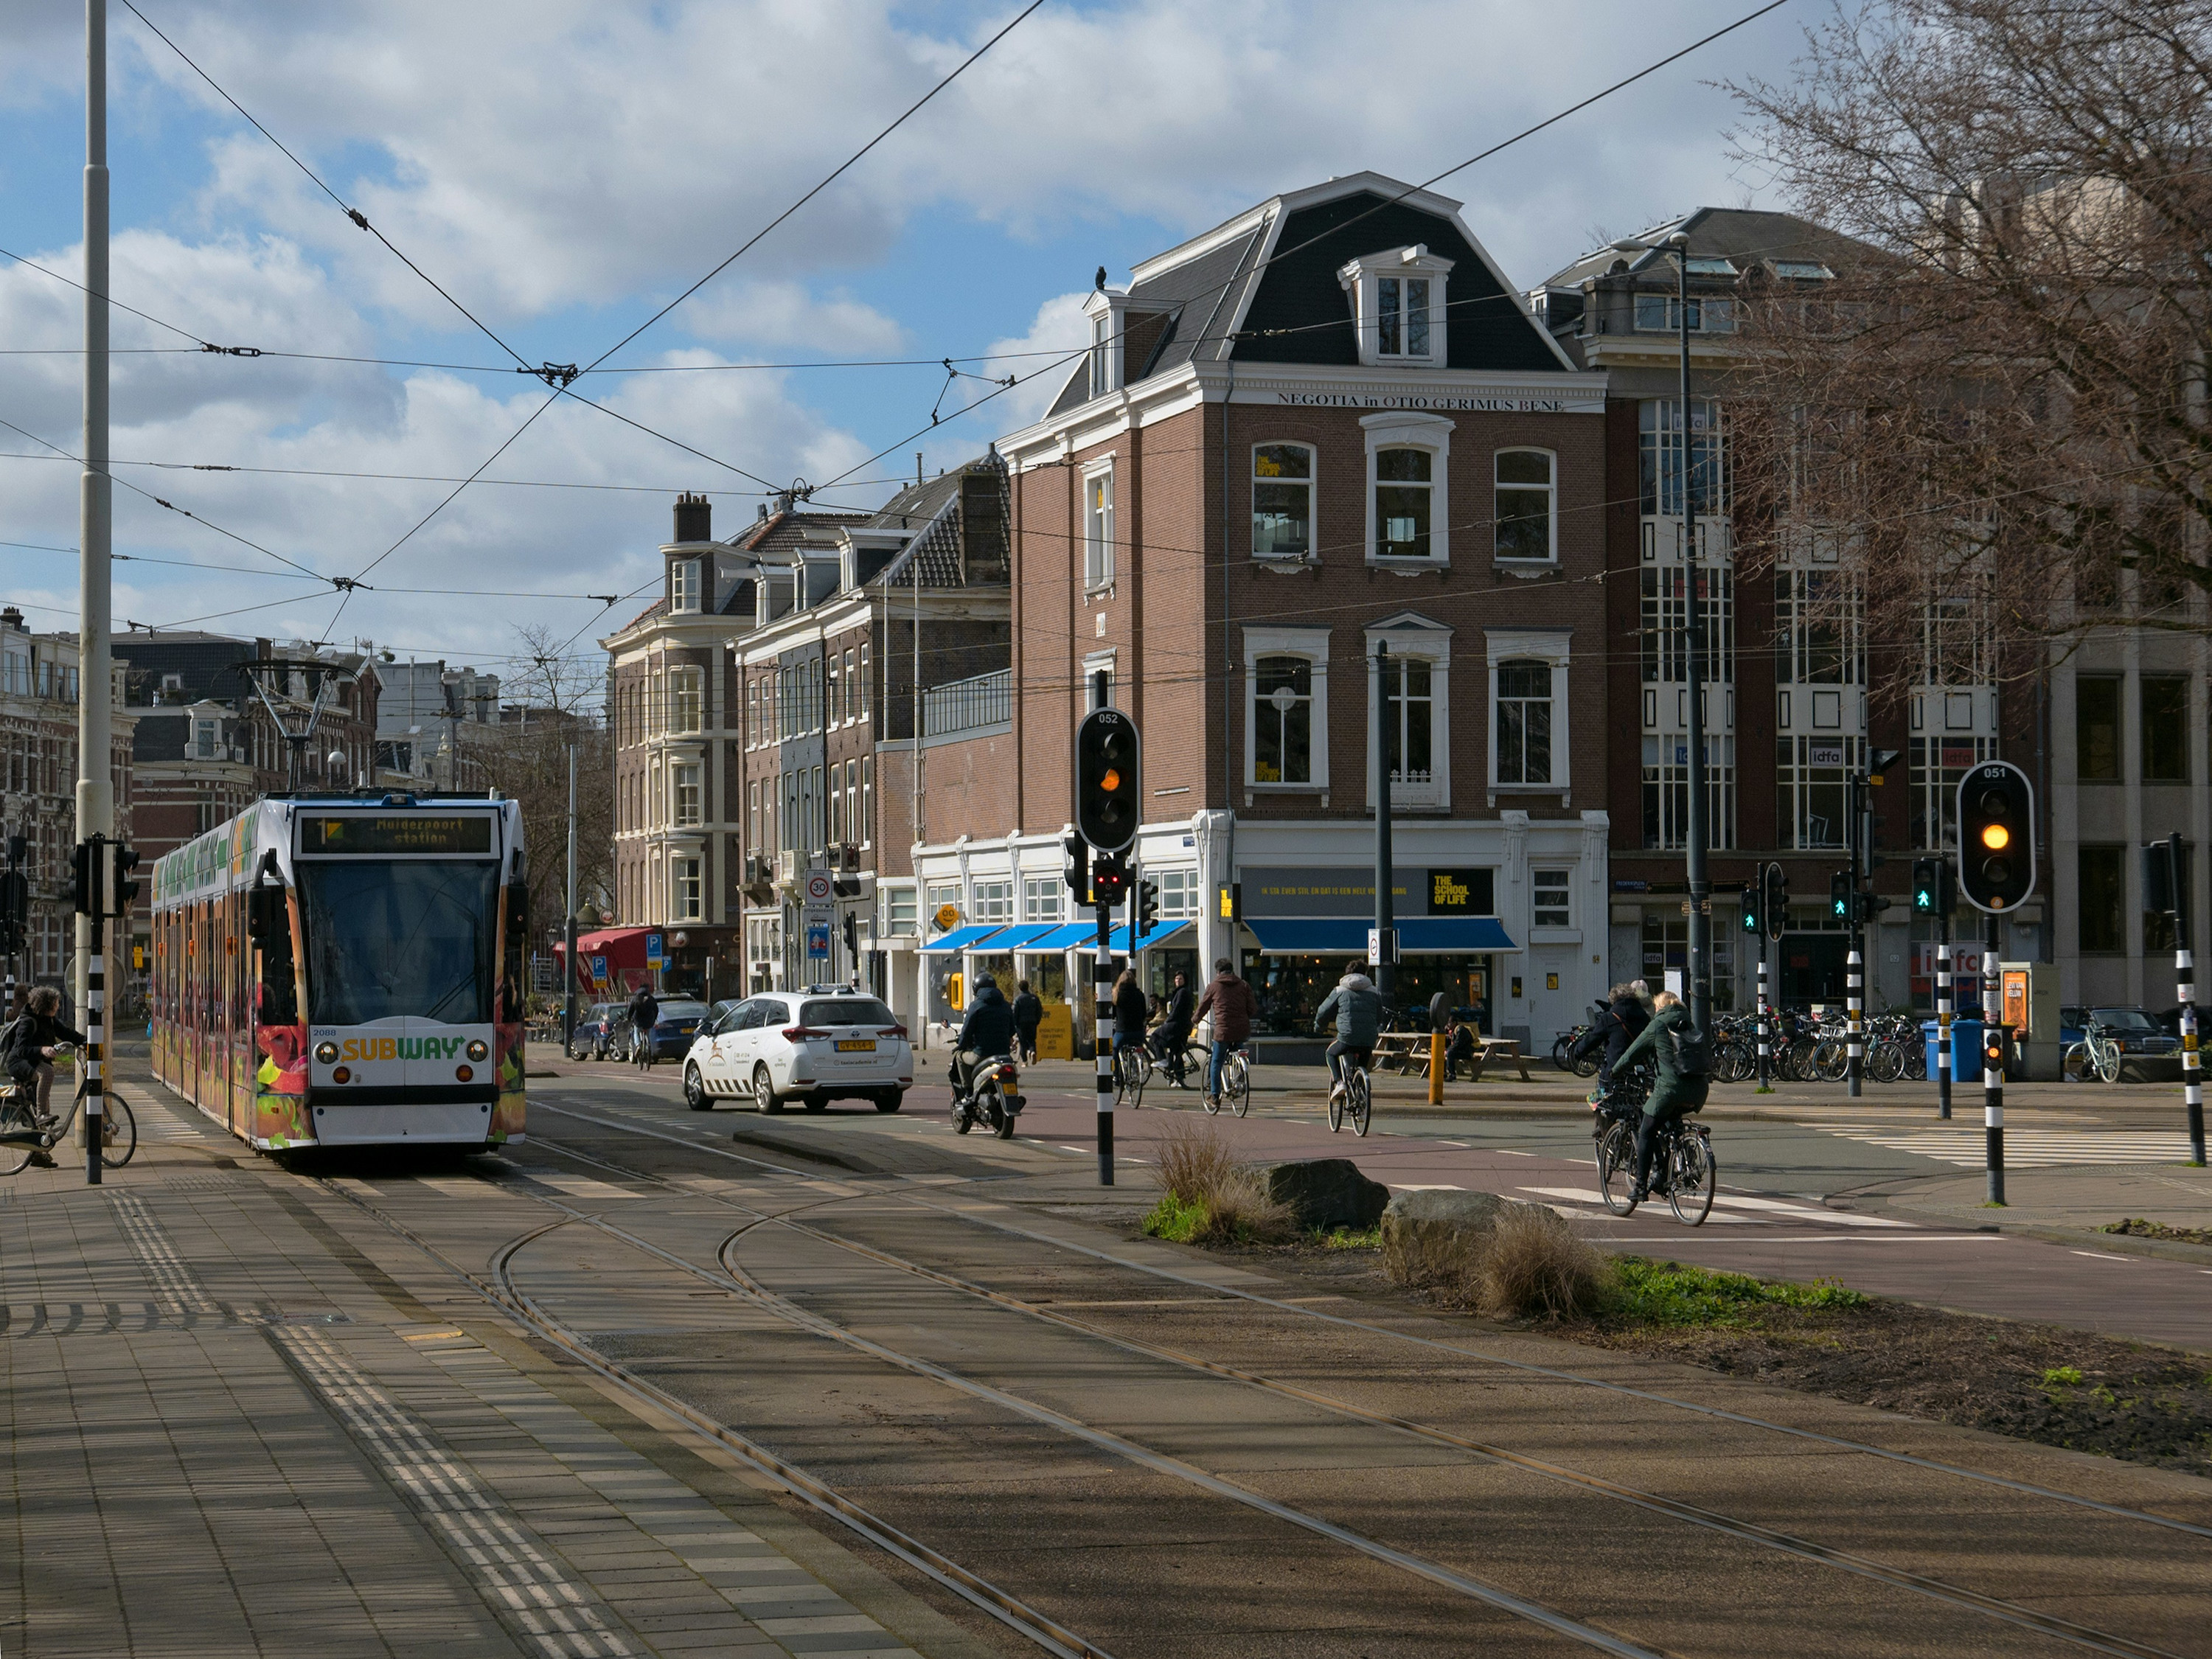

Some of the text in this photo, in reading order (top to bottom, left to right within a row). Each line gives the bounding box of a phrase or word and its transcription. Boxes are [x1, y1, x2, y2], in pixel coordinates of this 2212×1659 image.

[1278, 393, 1564, 411] NEGOTIA in OTIO GERIMUS BENE
[1677, 417, 1703, 428] ia
[1099, 714, 1118, 723] 052
[1814, 751, 1840, 762] idfa
[1945, 752, 1971, 764] idfa
[1984, 768, 2006, 778] 051
[376, 818, 463, 830] Muiderpoort
[317, 818, 326, 844] 1
[394, 832, 447, 844] station
[1434, 875, 1452, 885] THE
[813, 883, 826, 891] 30
[1434, 885, 1470, 895] SCHOOL
[1434, 894, 1466, 905] OF LIFE
[650, 936, 658, 948] P
[1645, 954, 1660, 962] idfa
[596, 959, 603, 969] P
[340, 1035, 466, 1062] SUBWAY
